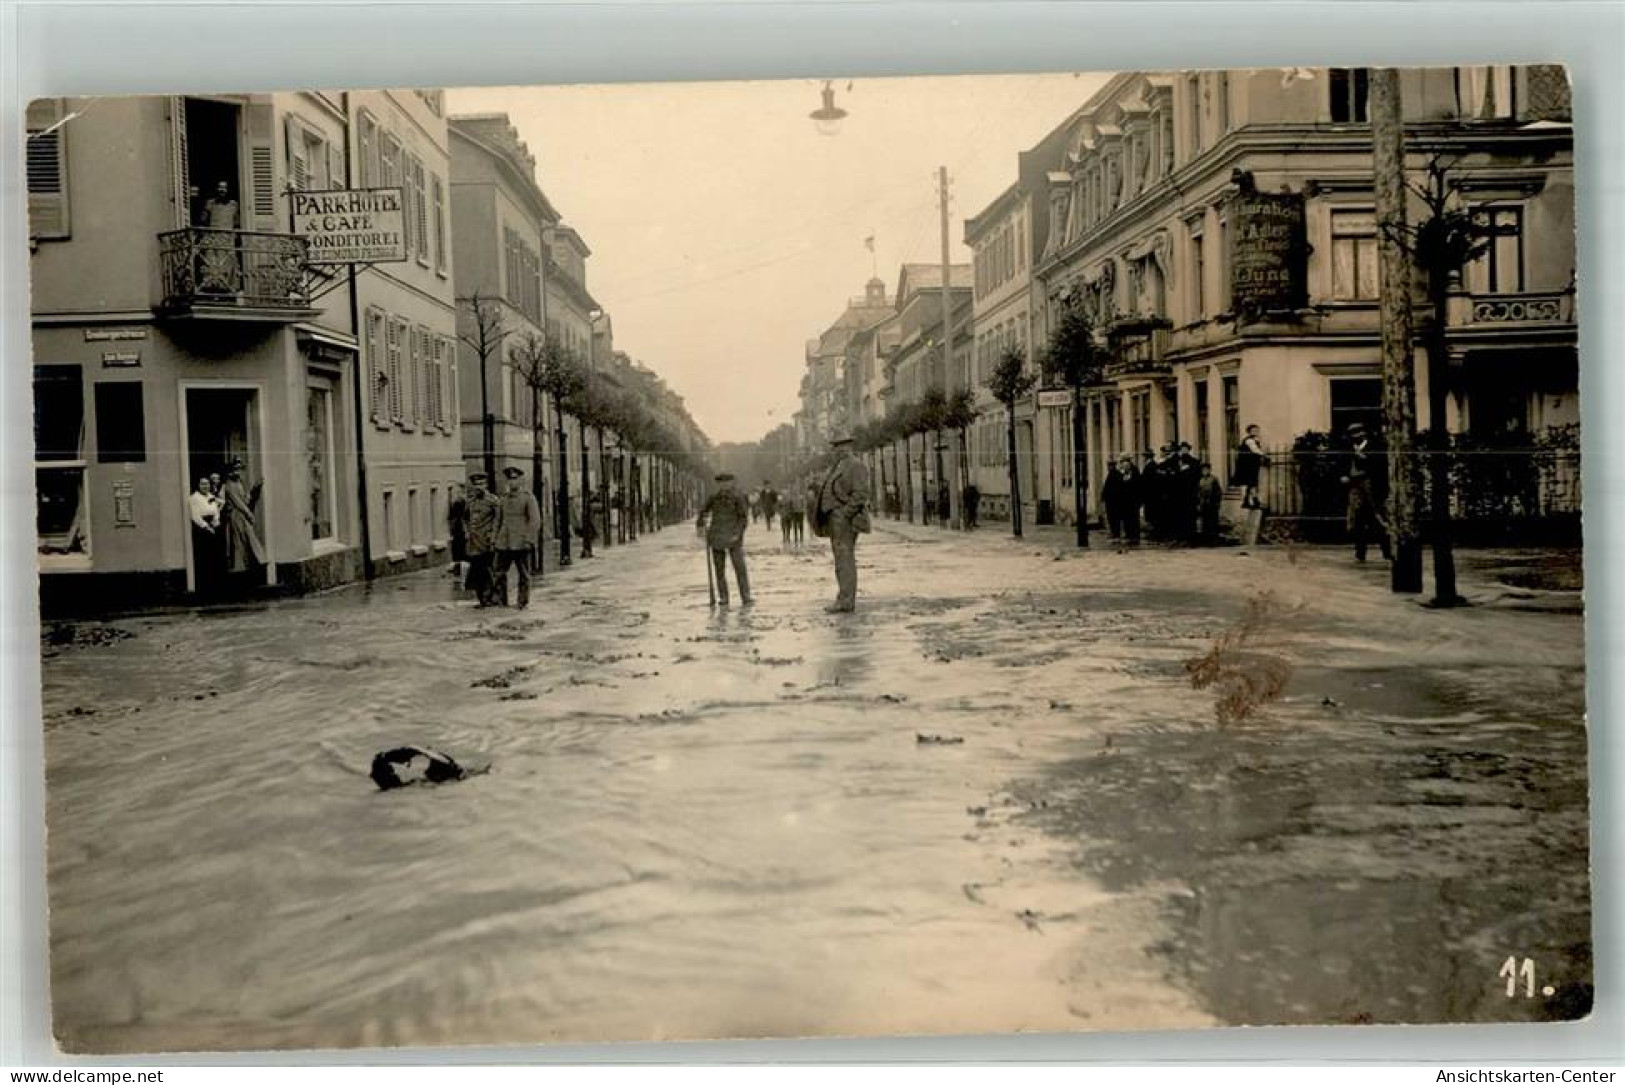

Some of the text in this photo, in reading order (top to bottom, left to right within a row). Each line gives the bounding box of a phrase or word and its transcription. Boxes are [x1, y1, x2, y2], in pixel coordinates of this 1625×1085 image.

[305, 218, 319, 231] &
[303, 232, 399, 248] ONDITOREI
[1499, 956, 1556, 998] 11.
